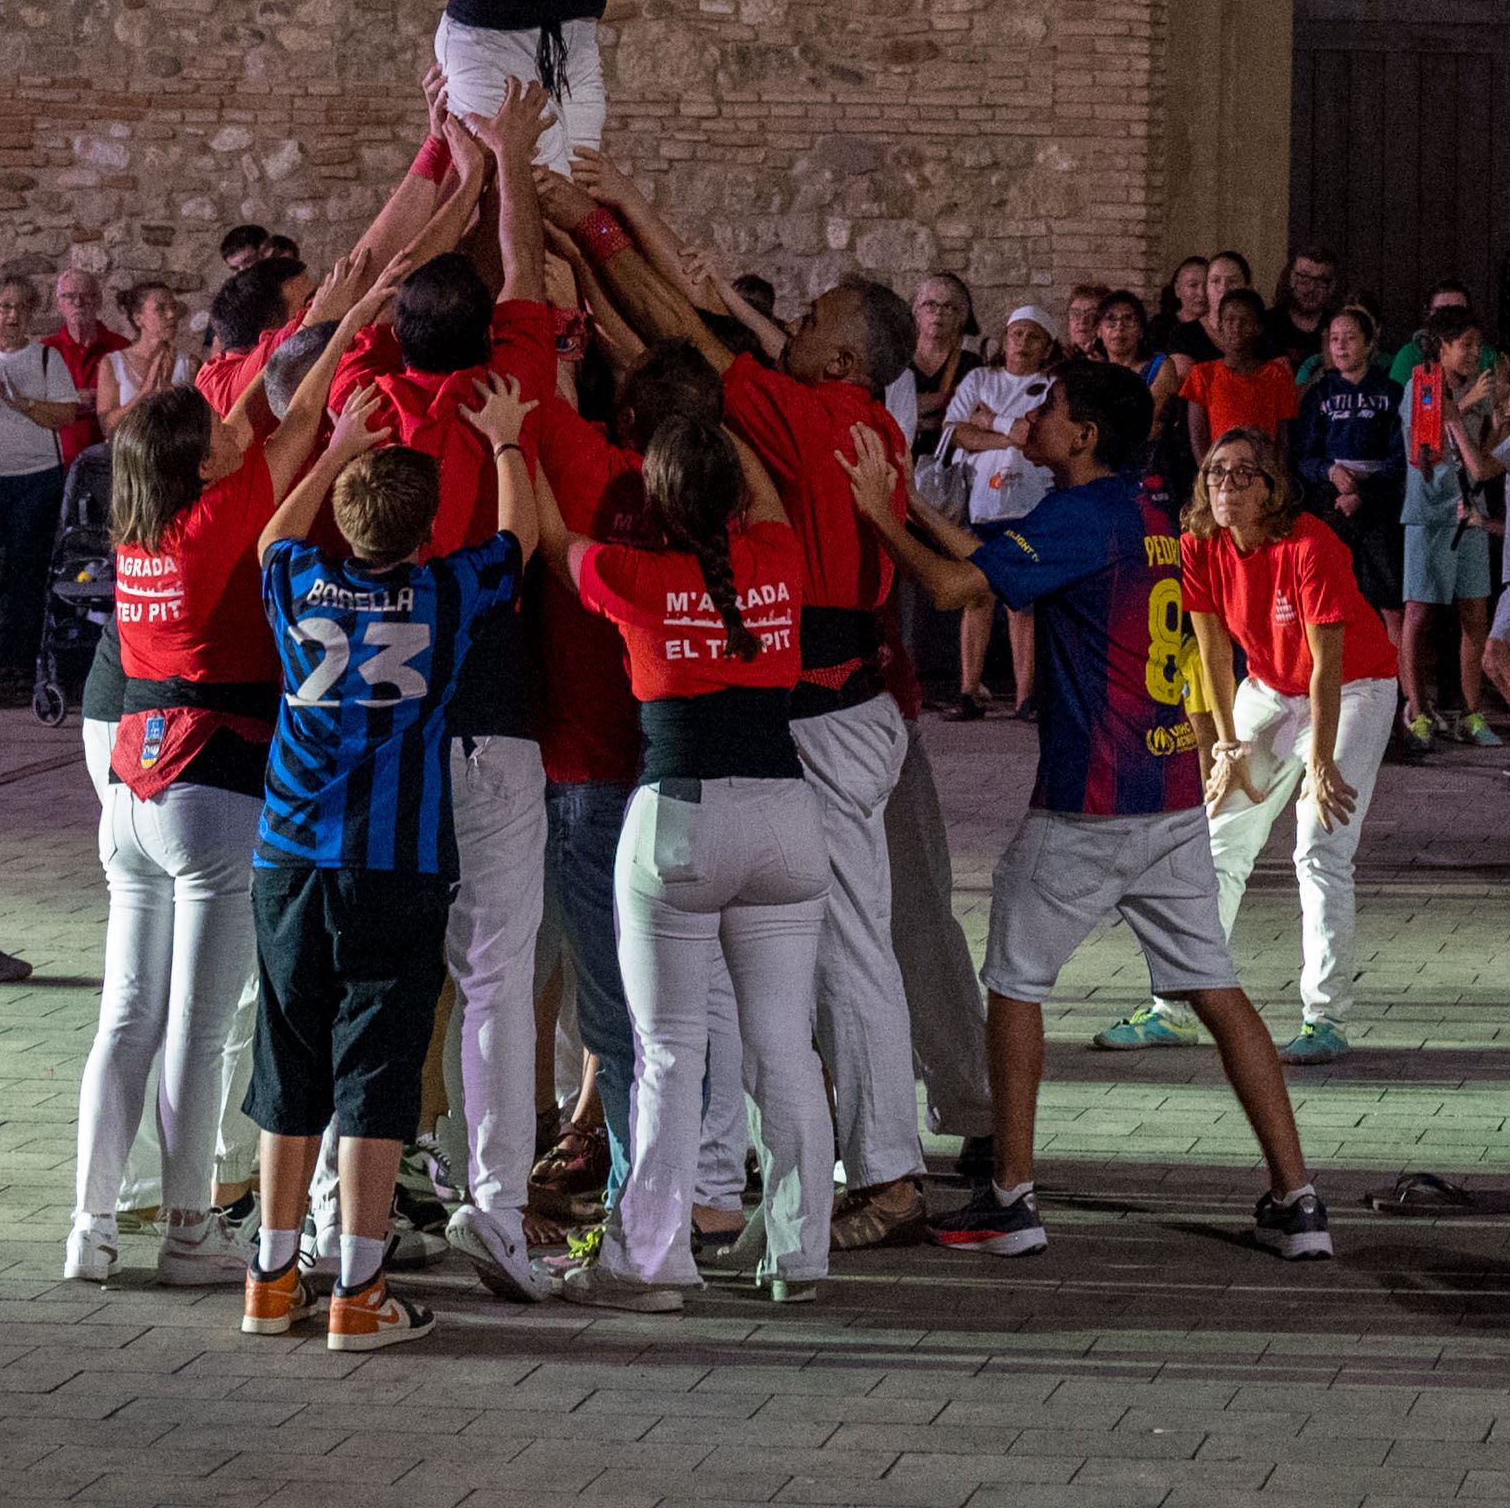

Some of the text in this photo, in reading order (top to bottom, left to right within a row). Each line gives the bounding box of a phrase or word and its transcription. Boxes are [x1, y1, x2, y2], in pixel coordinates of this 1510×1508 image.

[148, 598, 183, 624] PIT
[306, 578, 415, 613] BARELLA
[666, 581, 791, 613] M'ARADA
[665, 639, 700, 660] EL
[1144, 577, 1183, 706] 8
[285, 617, 430, 707] 23
